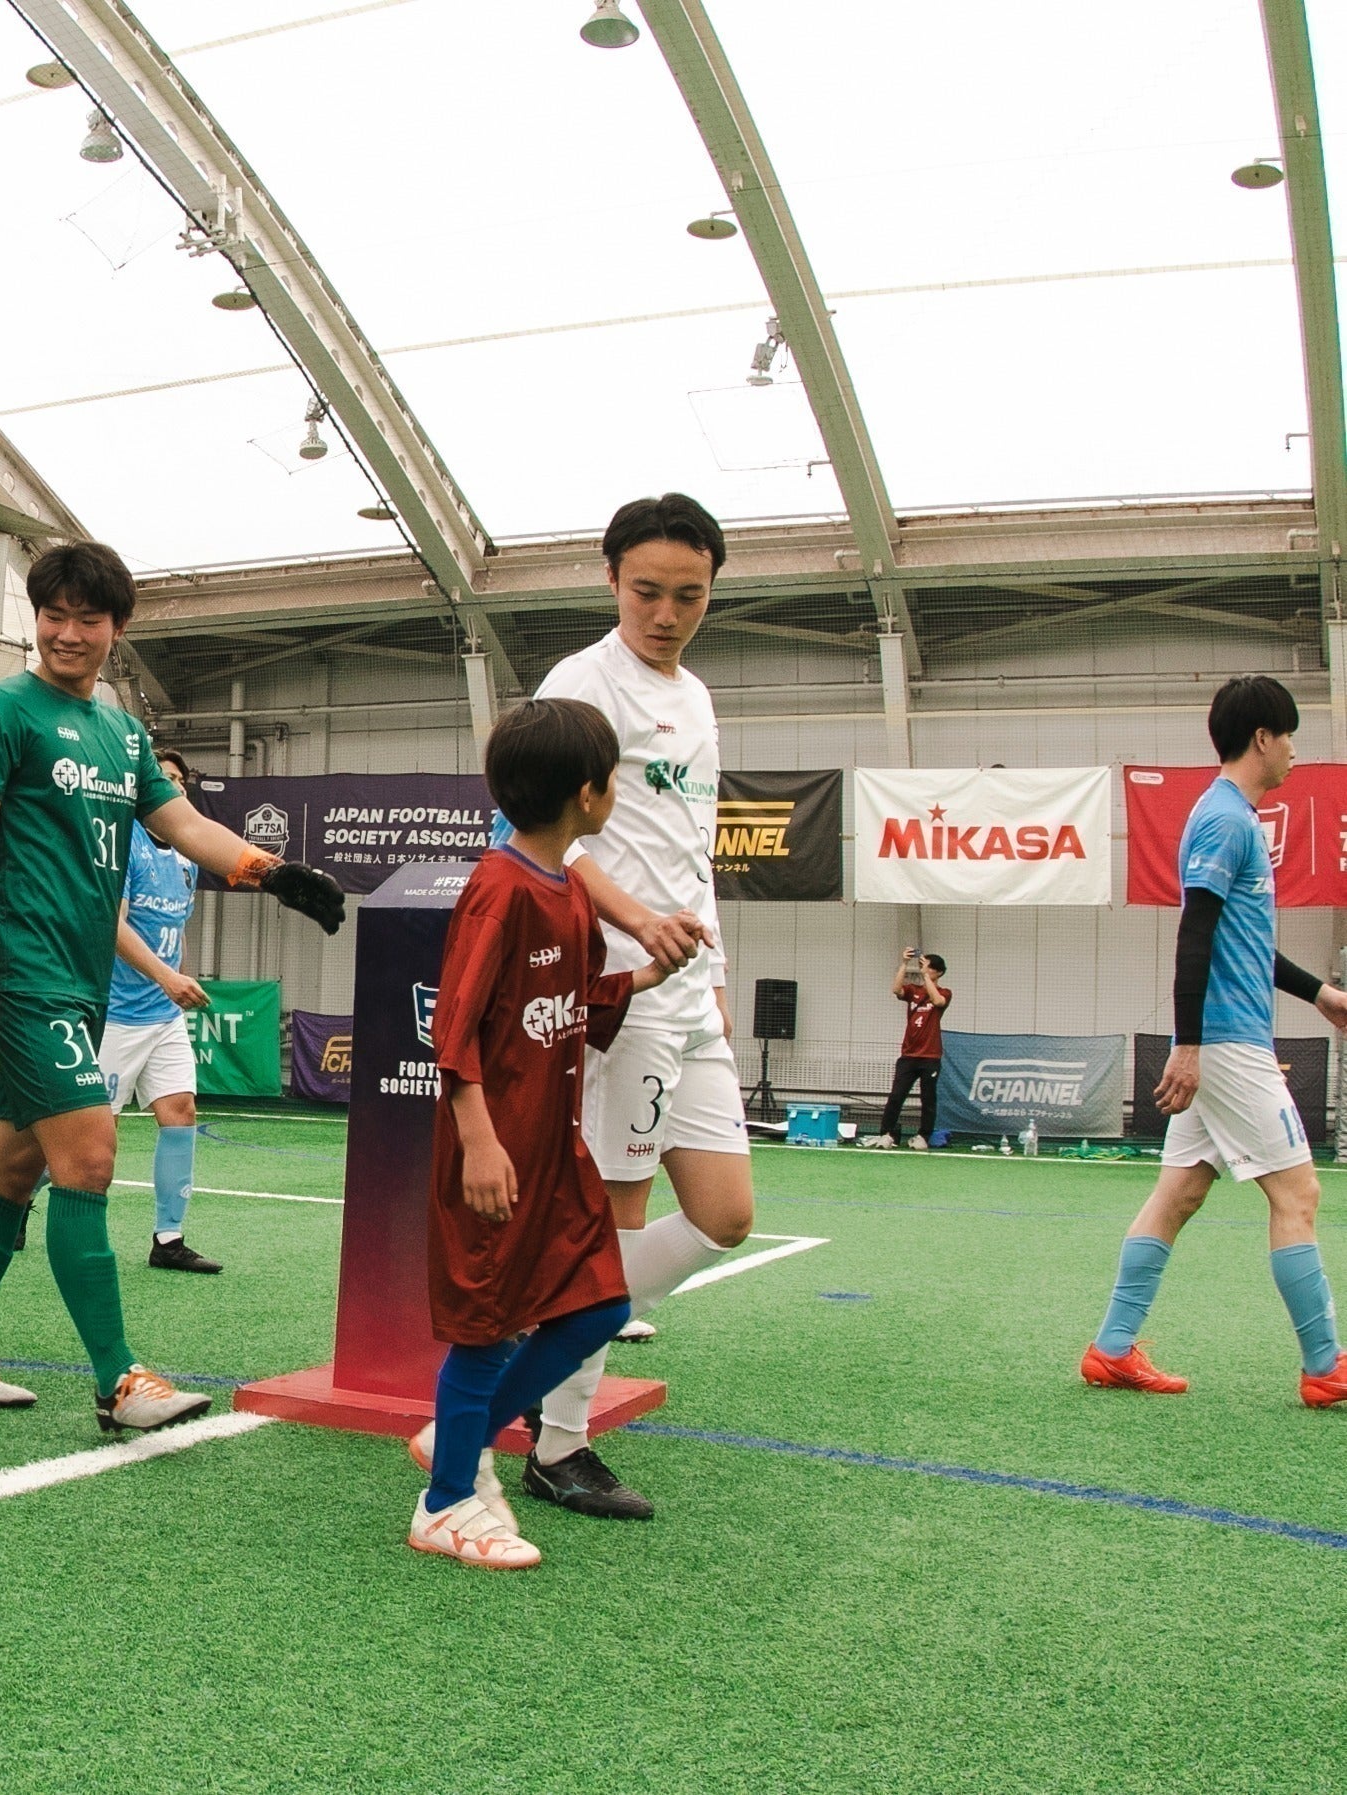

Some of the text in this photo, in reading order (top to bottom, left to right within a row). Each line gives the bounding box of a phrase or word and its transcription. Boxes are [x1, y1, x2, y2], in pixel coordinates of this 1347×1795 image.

[323, 807, 384, 824] JAPAN
[387, 807, 484, 825] FOOTBALL
[250, 823, 283, 834] JF7SA
[92, 817, 120, 871] 31
[323, 829, 403, 846] SOCIETY
[324, 852, 382, 864] 一般社団法人
[133, 893, 161, 910] ZAC
[405, 889, 427, 897] MADE
[428, 889, 440, 897] OF
[156, 926, 178, 958] 29
[914, 1016, 924, 1028] 4
[49, 1018, 100, 1070] 31
[399, 1060, 441, 1077] FOOT
[630, 1074, 666, 1135] 3
[626, 1142, 655, 1158] SDB
